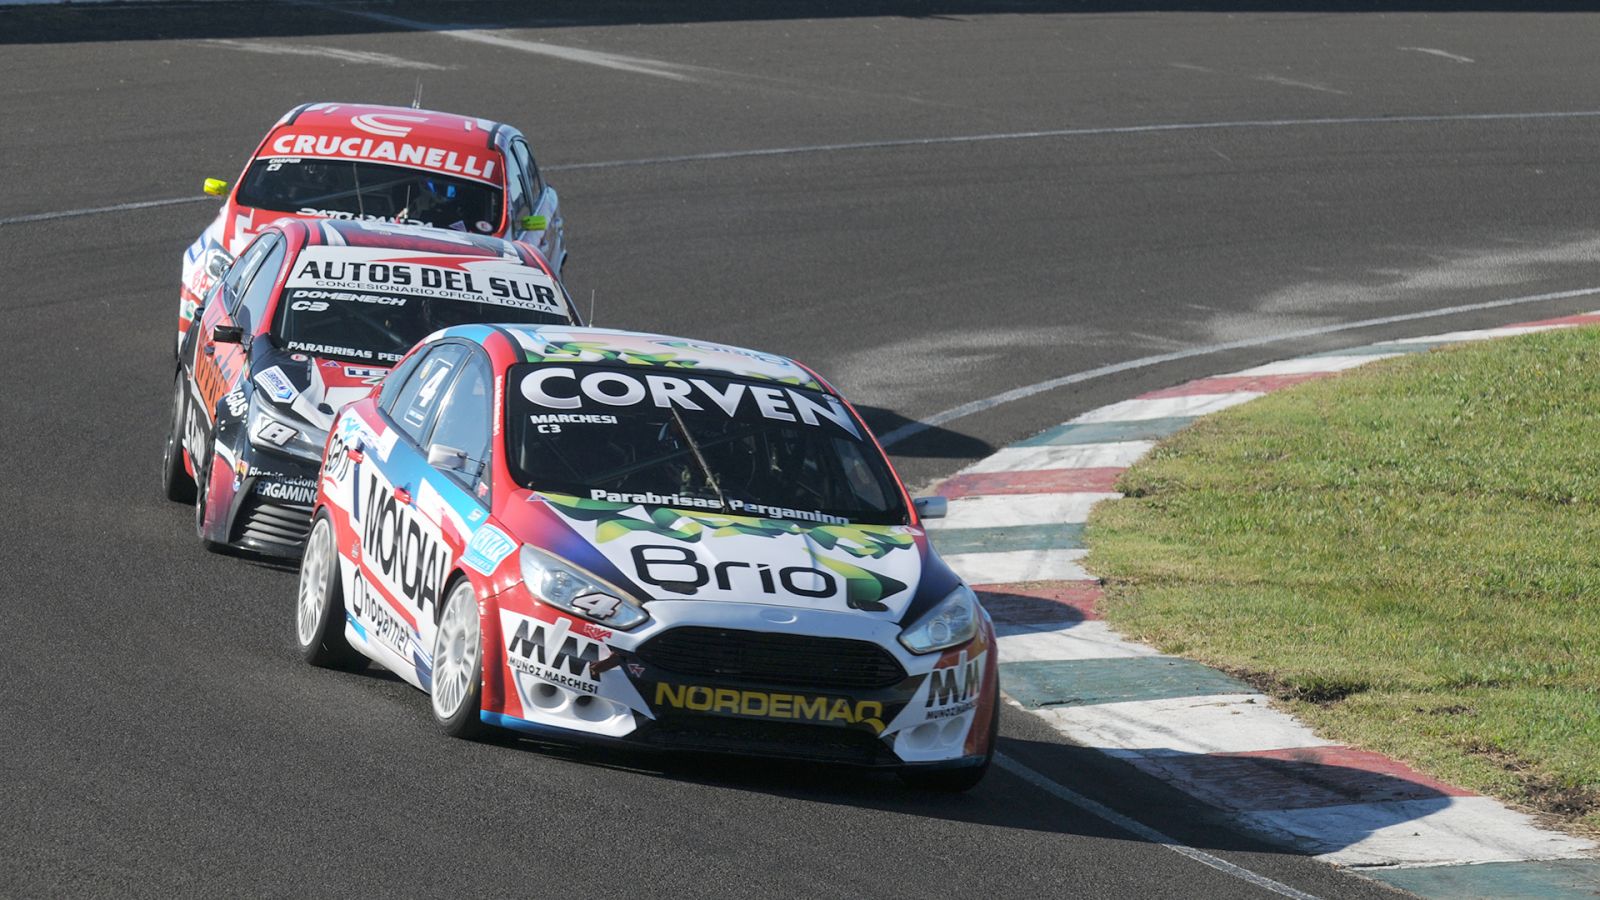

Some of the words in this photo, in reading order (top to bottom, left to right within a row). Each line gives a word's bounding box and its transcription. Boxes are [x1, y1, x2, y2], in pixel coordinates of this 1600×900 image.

[273, 134, 495, 179] CRUCIANELLI
[293, 290, 407, 306] DOMENECH
[298, 261, 411, 285] AUTOS
[422, 268, 482, 294] DEL
[489, 277, 559, 307] SUR
[316, 280, 436, 295] CONCESIONARIO
[439, 290, 493, 304] OFICIAL
[499, 299, 553, 312] TOYOTA
[291, 301, 330, 312] C3
[287, 341, 373, 359] PARABRISAS
[419, 366, 449, 407] 4
[520, 367, 862, 441] CORVEN
[530, 414, 618, 424] MARCHESI
[537, 425, 562, 434] C3
[590, 489, 723, 509] Parabrisas
[364, 473, 447, 627] MONDIAL
[630, 544, 838, 599] Brio
[571, 592, 622, 621] 4
[543, 671, 599, 695] MARCHESI
